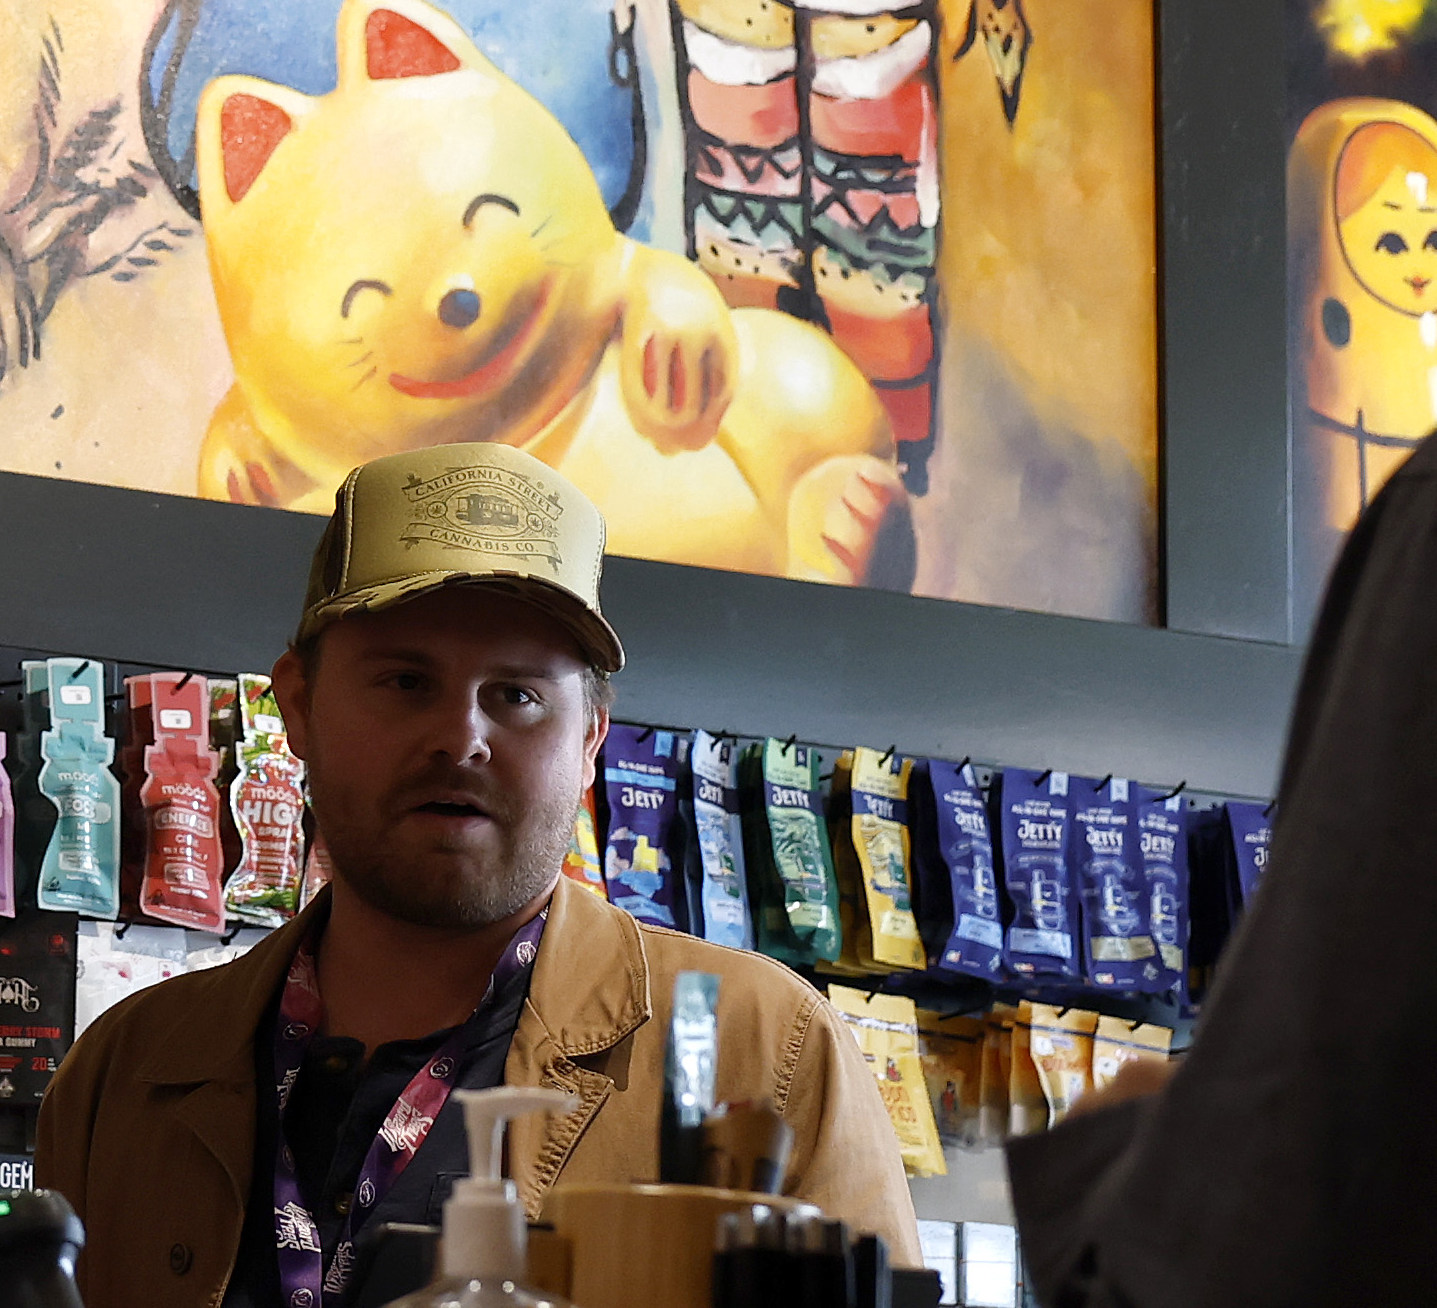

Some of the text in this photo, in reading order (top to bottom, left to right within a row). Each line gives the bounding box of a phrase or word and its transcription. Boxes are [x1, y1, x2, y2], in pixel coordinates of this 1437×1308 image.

[416, 470, 552, 512] CALIFORNIA STREET
[430, 529, 538, 552] CANNABIS CO.
[1017, 820, 1062, 840] JETTY
[25, 1027, 61, 1039] STORM
[4, 1037, 37, 1048] GUMMY
[32, 1056, 47, 1071] 20
